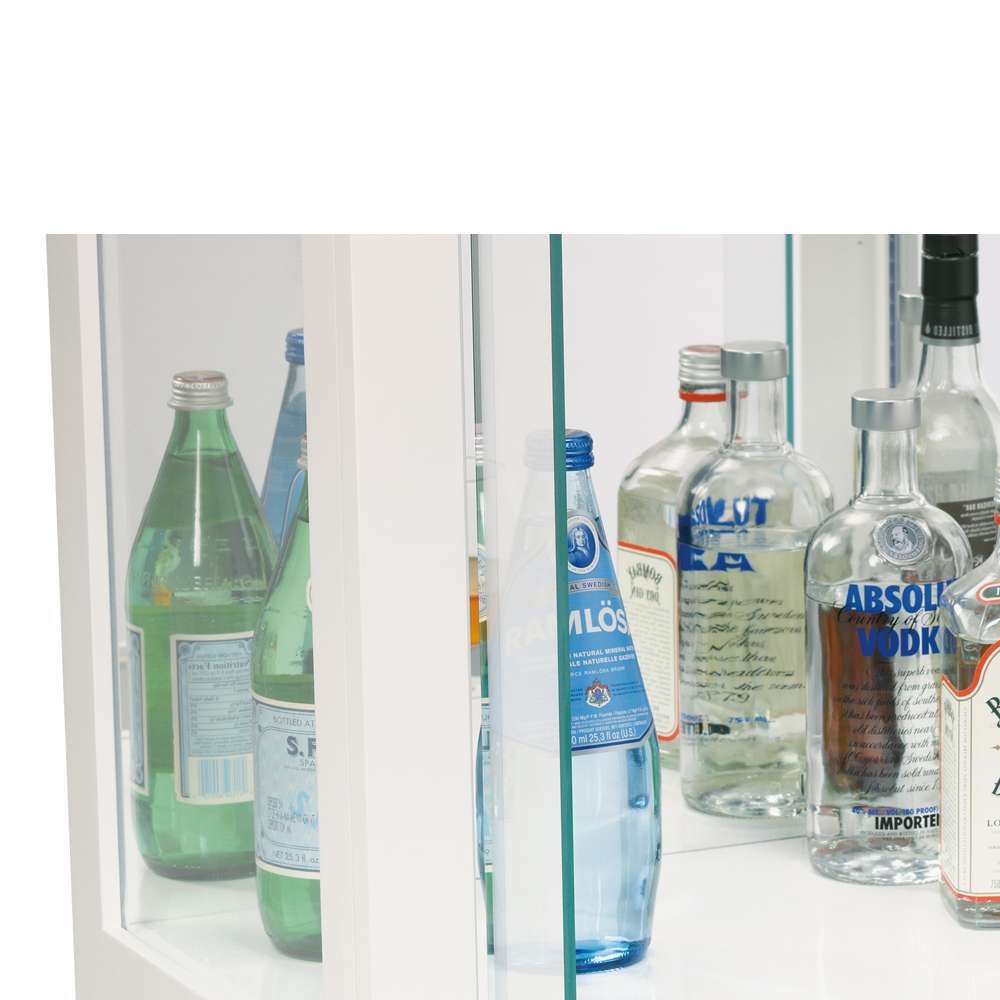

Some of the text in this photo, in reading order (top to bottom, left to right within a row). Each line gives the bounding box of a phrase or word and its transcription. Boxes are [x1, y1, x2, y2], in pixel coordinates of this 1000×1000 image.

[844, 578, 957, 615] ABSOL
[573, 648, 605, 659] NATURAL
[578, 734, 588, 744] ml
[588, 732, 606, 743] 25.3
